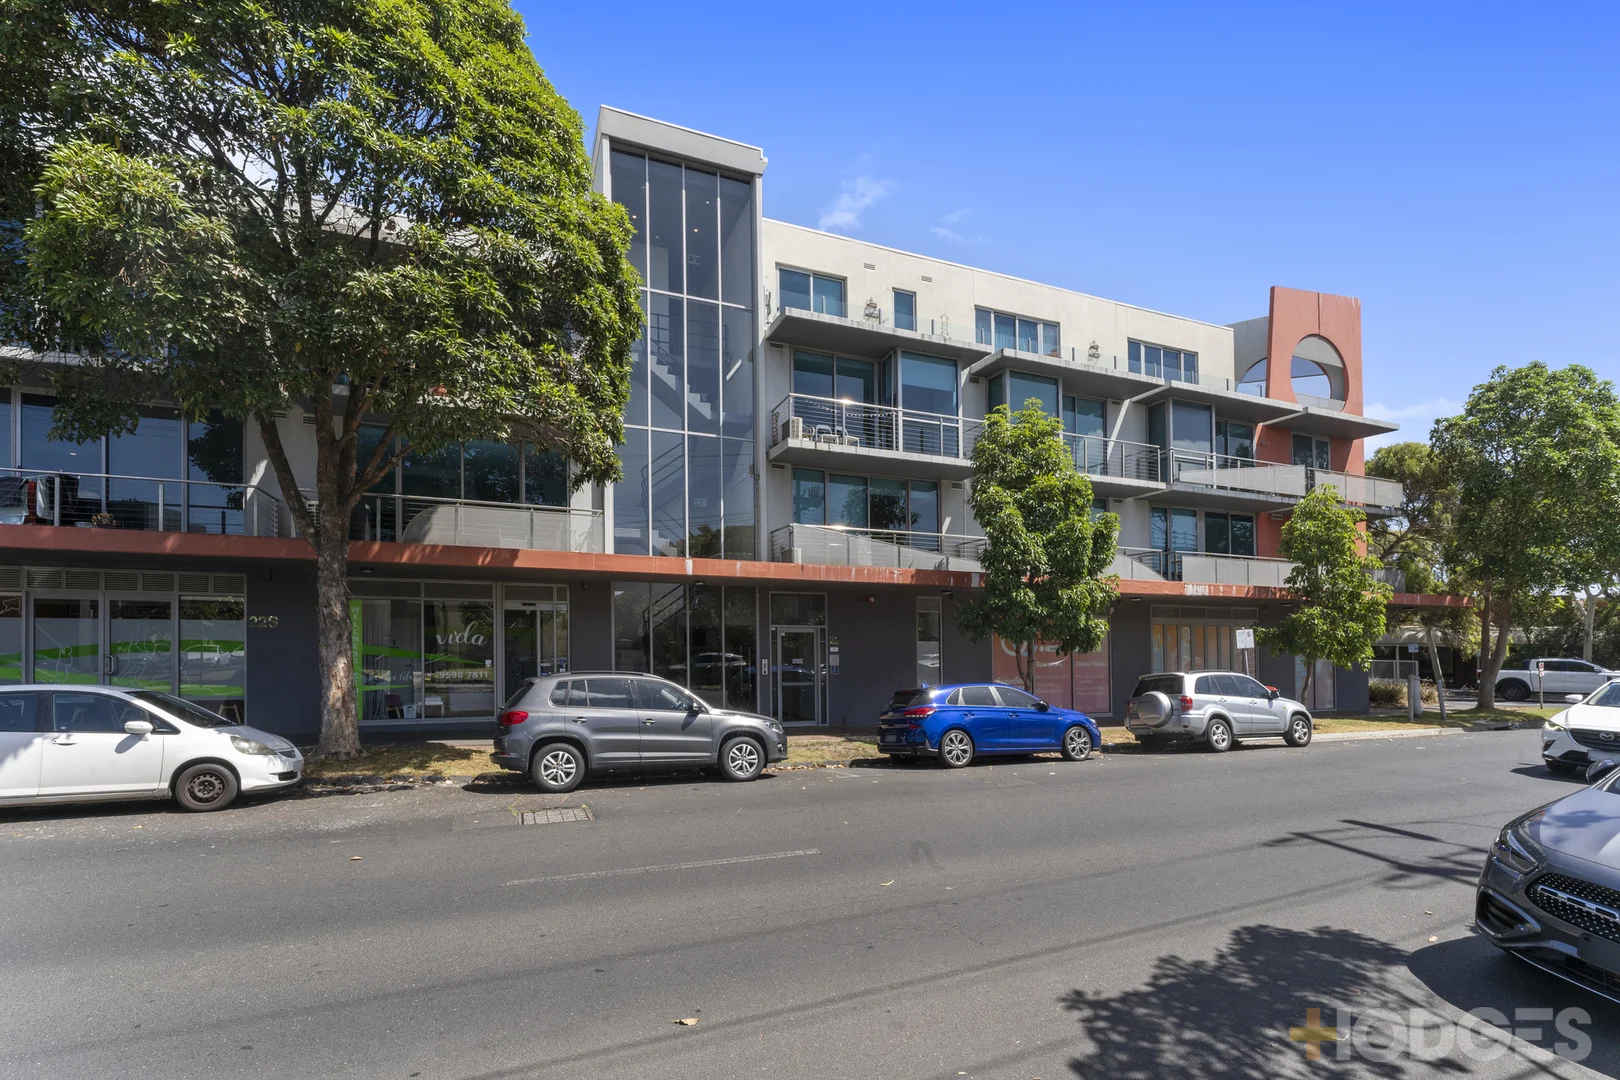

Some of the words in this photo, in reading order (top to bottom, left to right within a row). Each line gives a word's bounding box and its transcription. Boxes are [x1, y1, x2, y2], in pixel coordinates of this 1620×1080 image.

[351, 606, 360, 665] WELLNESS
[435, 620, 488, 646] vida
[439, 671, 463, 679] 9598
